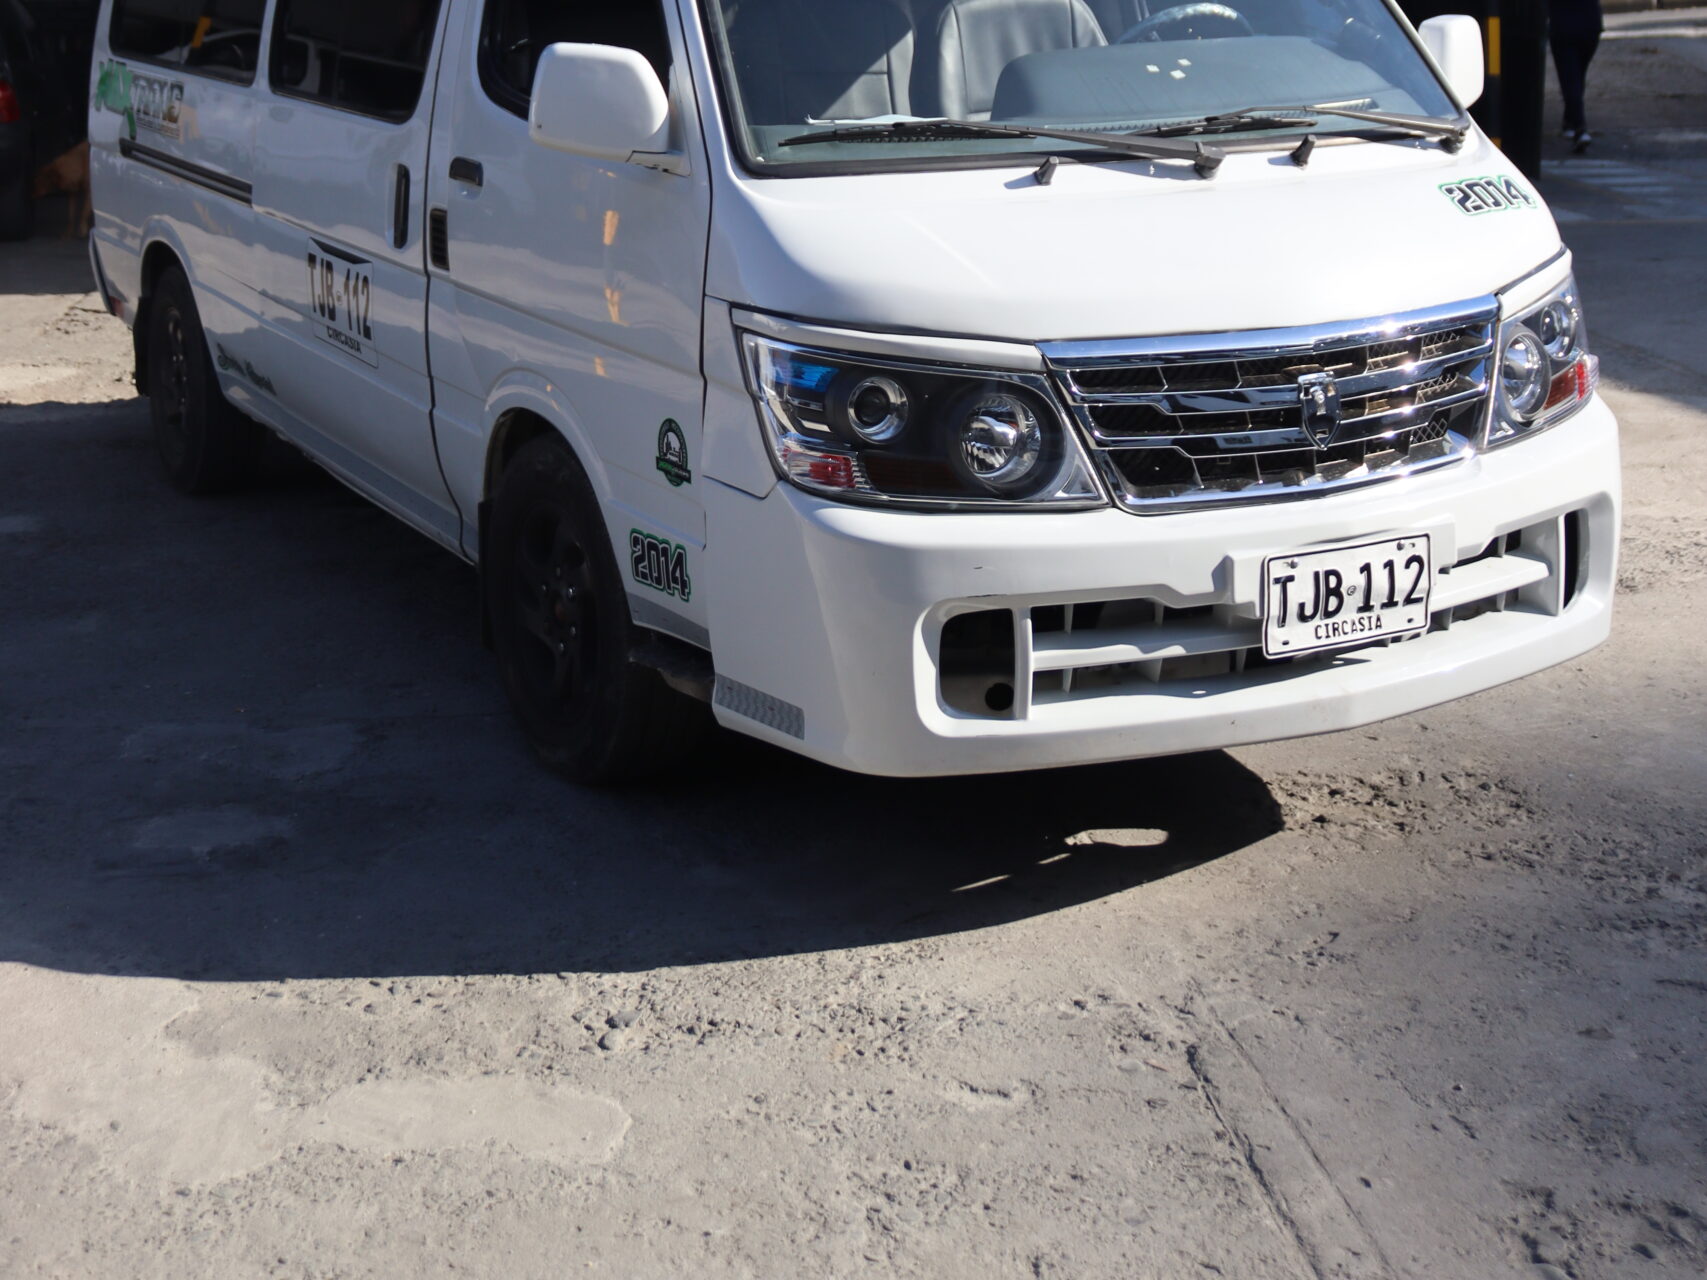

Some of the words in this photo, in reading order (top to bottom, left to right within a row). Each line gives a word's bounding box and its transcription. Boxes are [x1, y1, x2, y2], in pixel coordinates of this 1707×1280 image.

[1438, 175, 1537, 216] 2014
[307, 252, 337, 322] TJB
[343, 266, 373, 341] 112
[630, 528, 691, 603] 2014
[1272, 568, 1345, 629] TJB
[1356, 554, 1425, 614] 112
[1314, 613, 1383, 641] CIRCASIA
